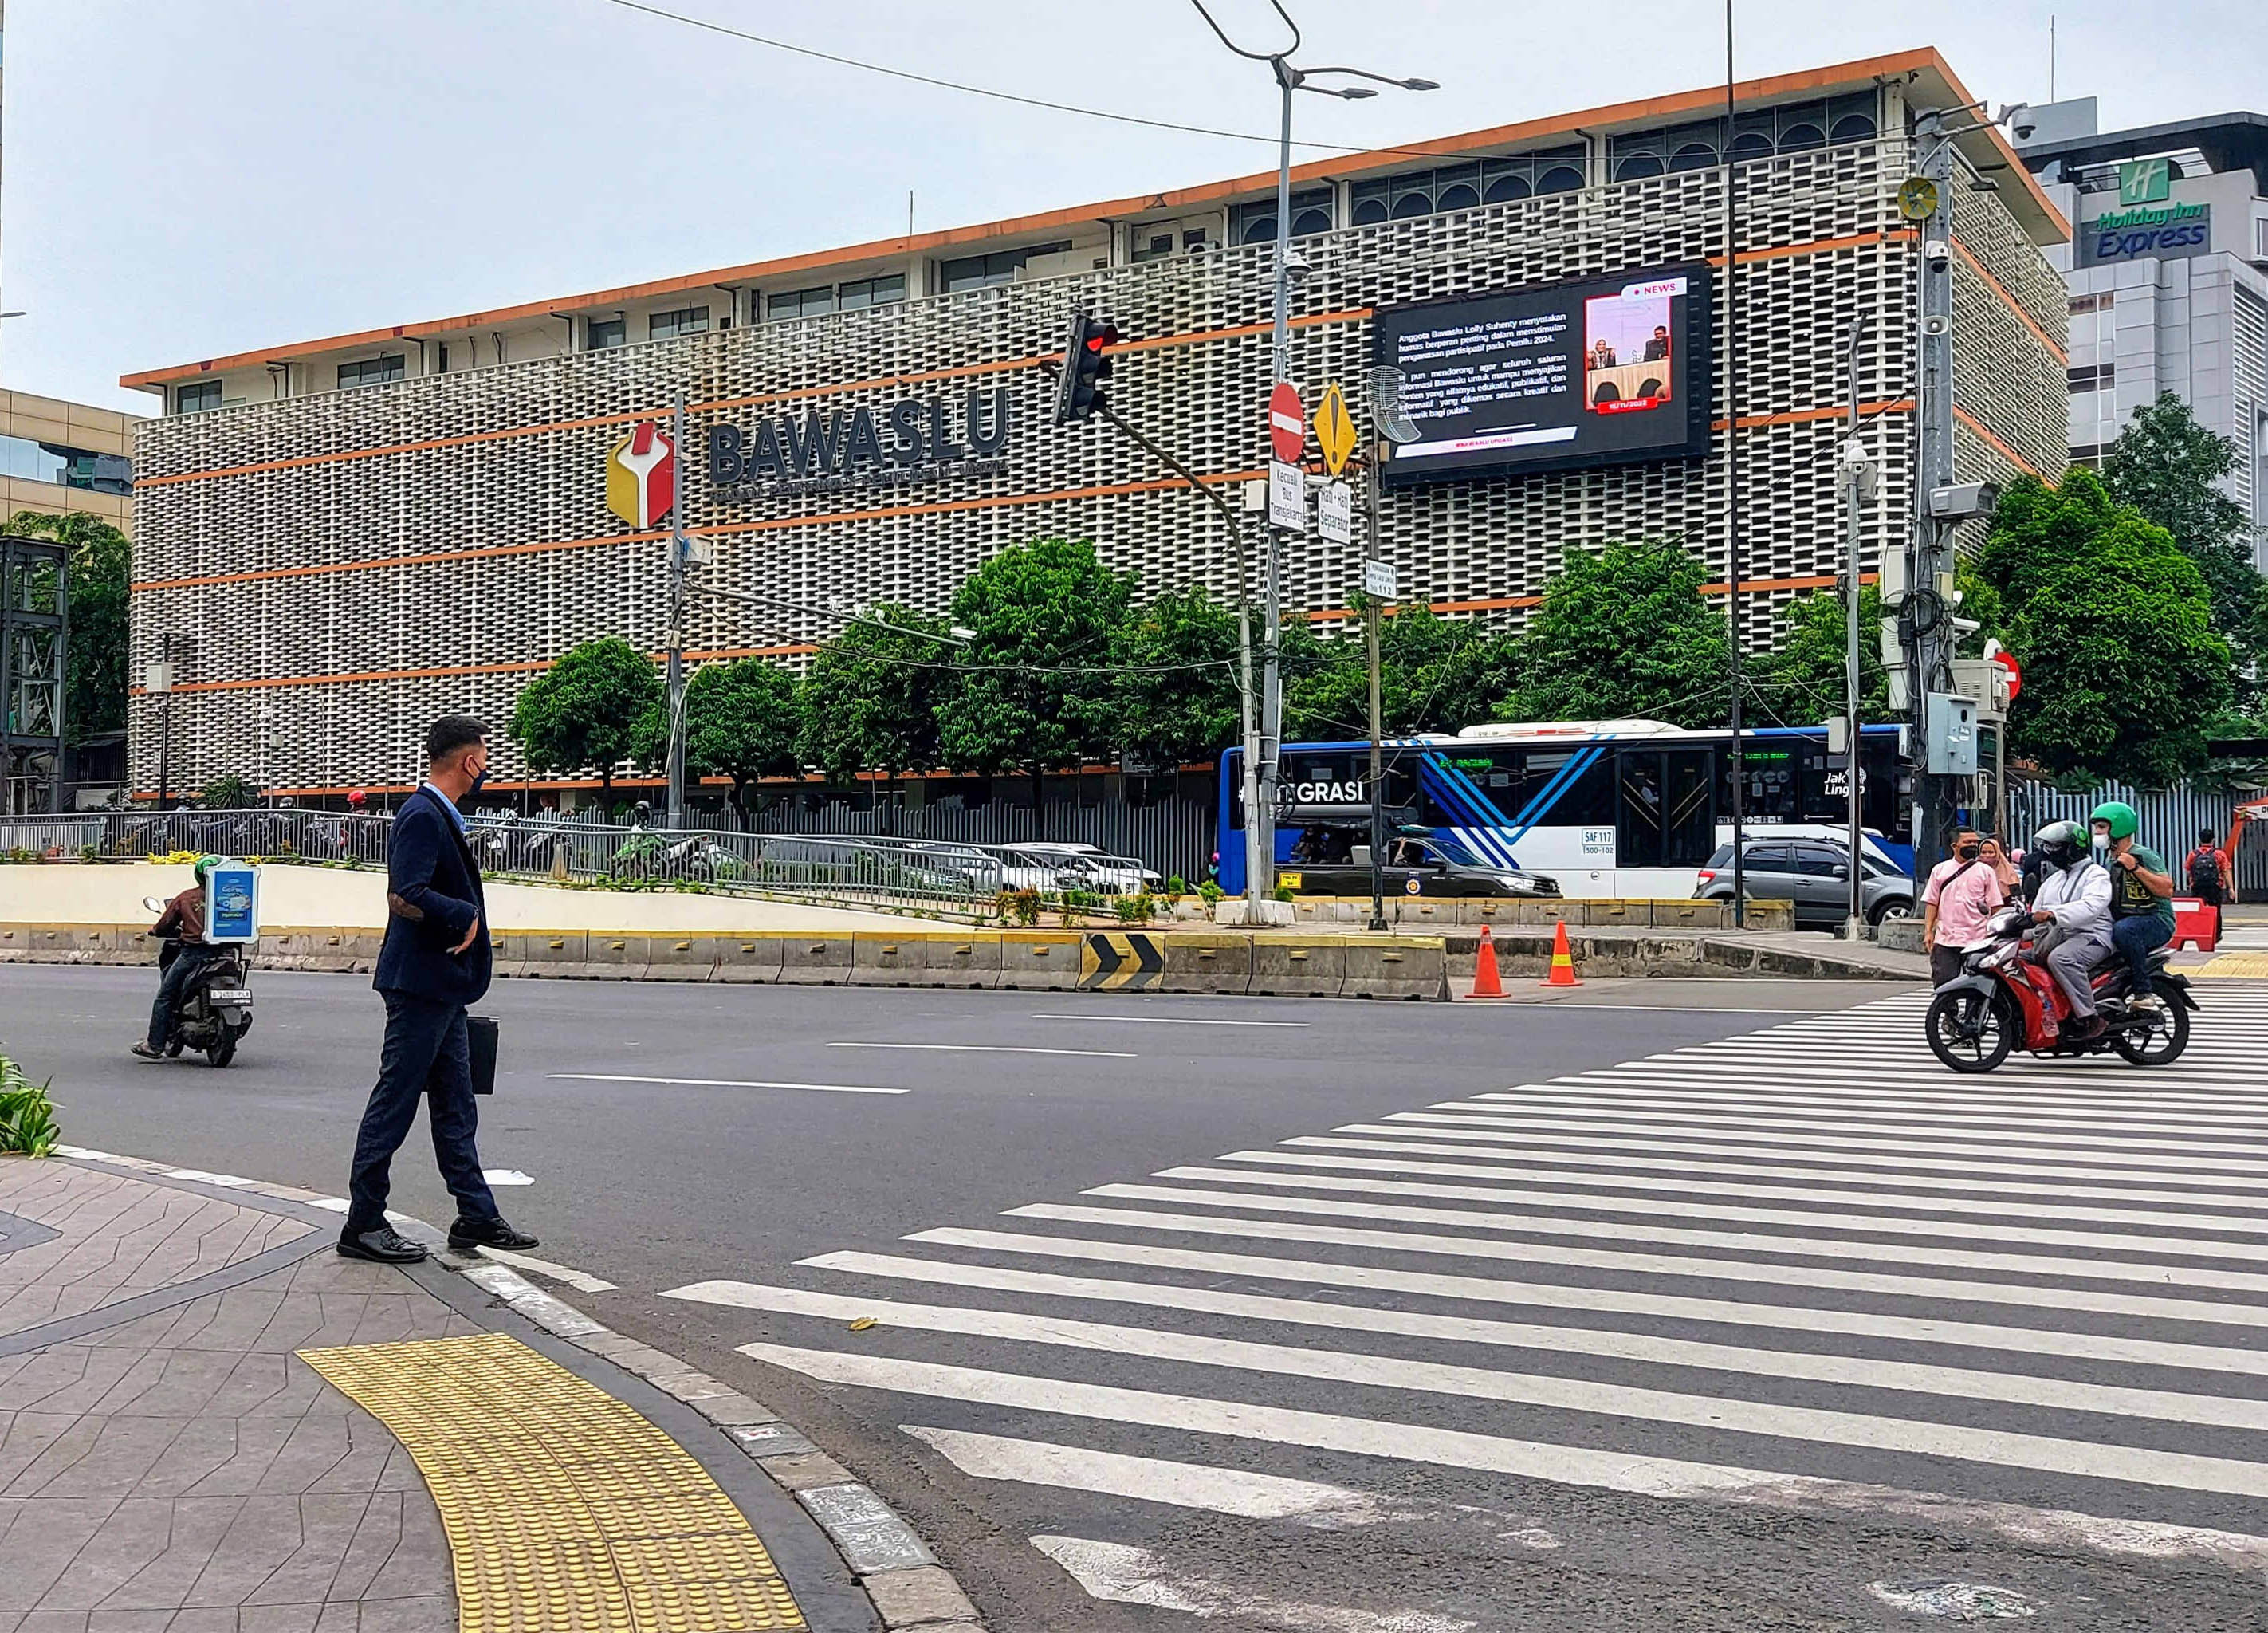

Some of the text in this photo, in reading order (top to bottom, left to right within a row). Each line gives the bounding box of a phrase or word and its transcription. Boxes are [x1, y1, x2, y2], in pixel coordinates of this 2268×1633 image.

[2097, 207, 2168, 231] Holiday
[2097, 225, 2206, 258] Express
[1644, 283, 1676, 295] NEWS
[1398, 313, 1566, 343] Anggota Bawaslu Lolly Suhenty menyatakan
[1398, 324, 1566, 352] humas berperan penting dalam menstimulan
[1398, 351, 1445, 364] pengawasan
[1445, 344, 1485, 357] partisipatif
[1486, 341, 1505, 352] pada
[1506, 338, 1533, 348] Pemilu
[1398, 364, 1566, 391] informasi Bawaslu untuk mampu menyajikan
[1410, 372, 1425, 382] pun
[1431, 367, 1474, 378] mendorong
[1479, 364, 1497, 372] agar
[1502, 357, 1531, 368] seluruh
[1537, 354, 1566, 364] saluran
[1425, 390, 1444, 399] yang
[1477, 380, 1510, 392] edukatif,
[1551, 374, 1566, 383] dan
[1439, 399, 1458, 408] yang
[1460, 394, 1493, 403] dikemas
[1496, 390, 1522, 399] secara
[1523, 386, 1549, 396] kreatif
[1551, 384, 1566, 393] dan
[1398, 405, 1472, 421] menarik bagi publik.
[709, 388, 1007, 484] BAWASLU
[1277, 469, 1297, 486] Kecuali
[1282, 486, 1292, 502] Bus
[1337, 490, 1348, 509] Hati
[1271, 502, 1303, 522] Transjakarta
[1320, 510, 1349, 532] Separator
[1824, 772, 1846, 784] Jak
[1824, 784, 1865, 797] Lingo
[1585, 832, 1611, 842] SAF 117
